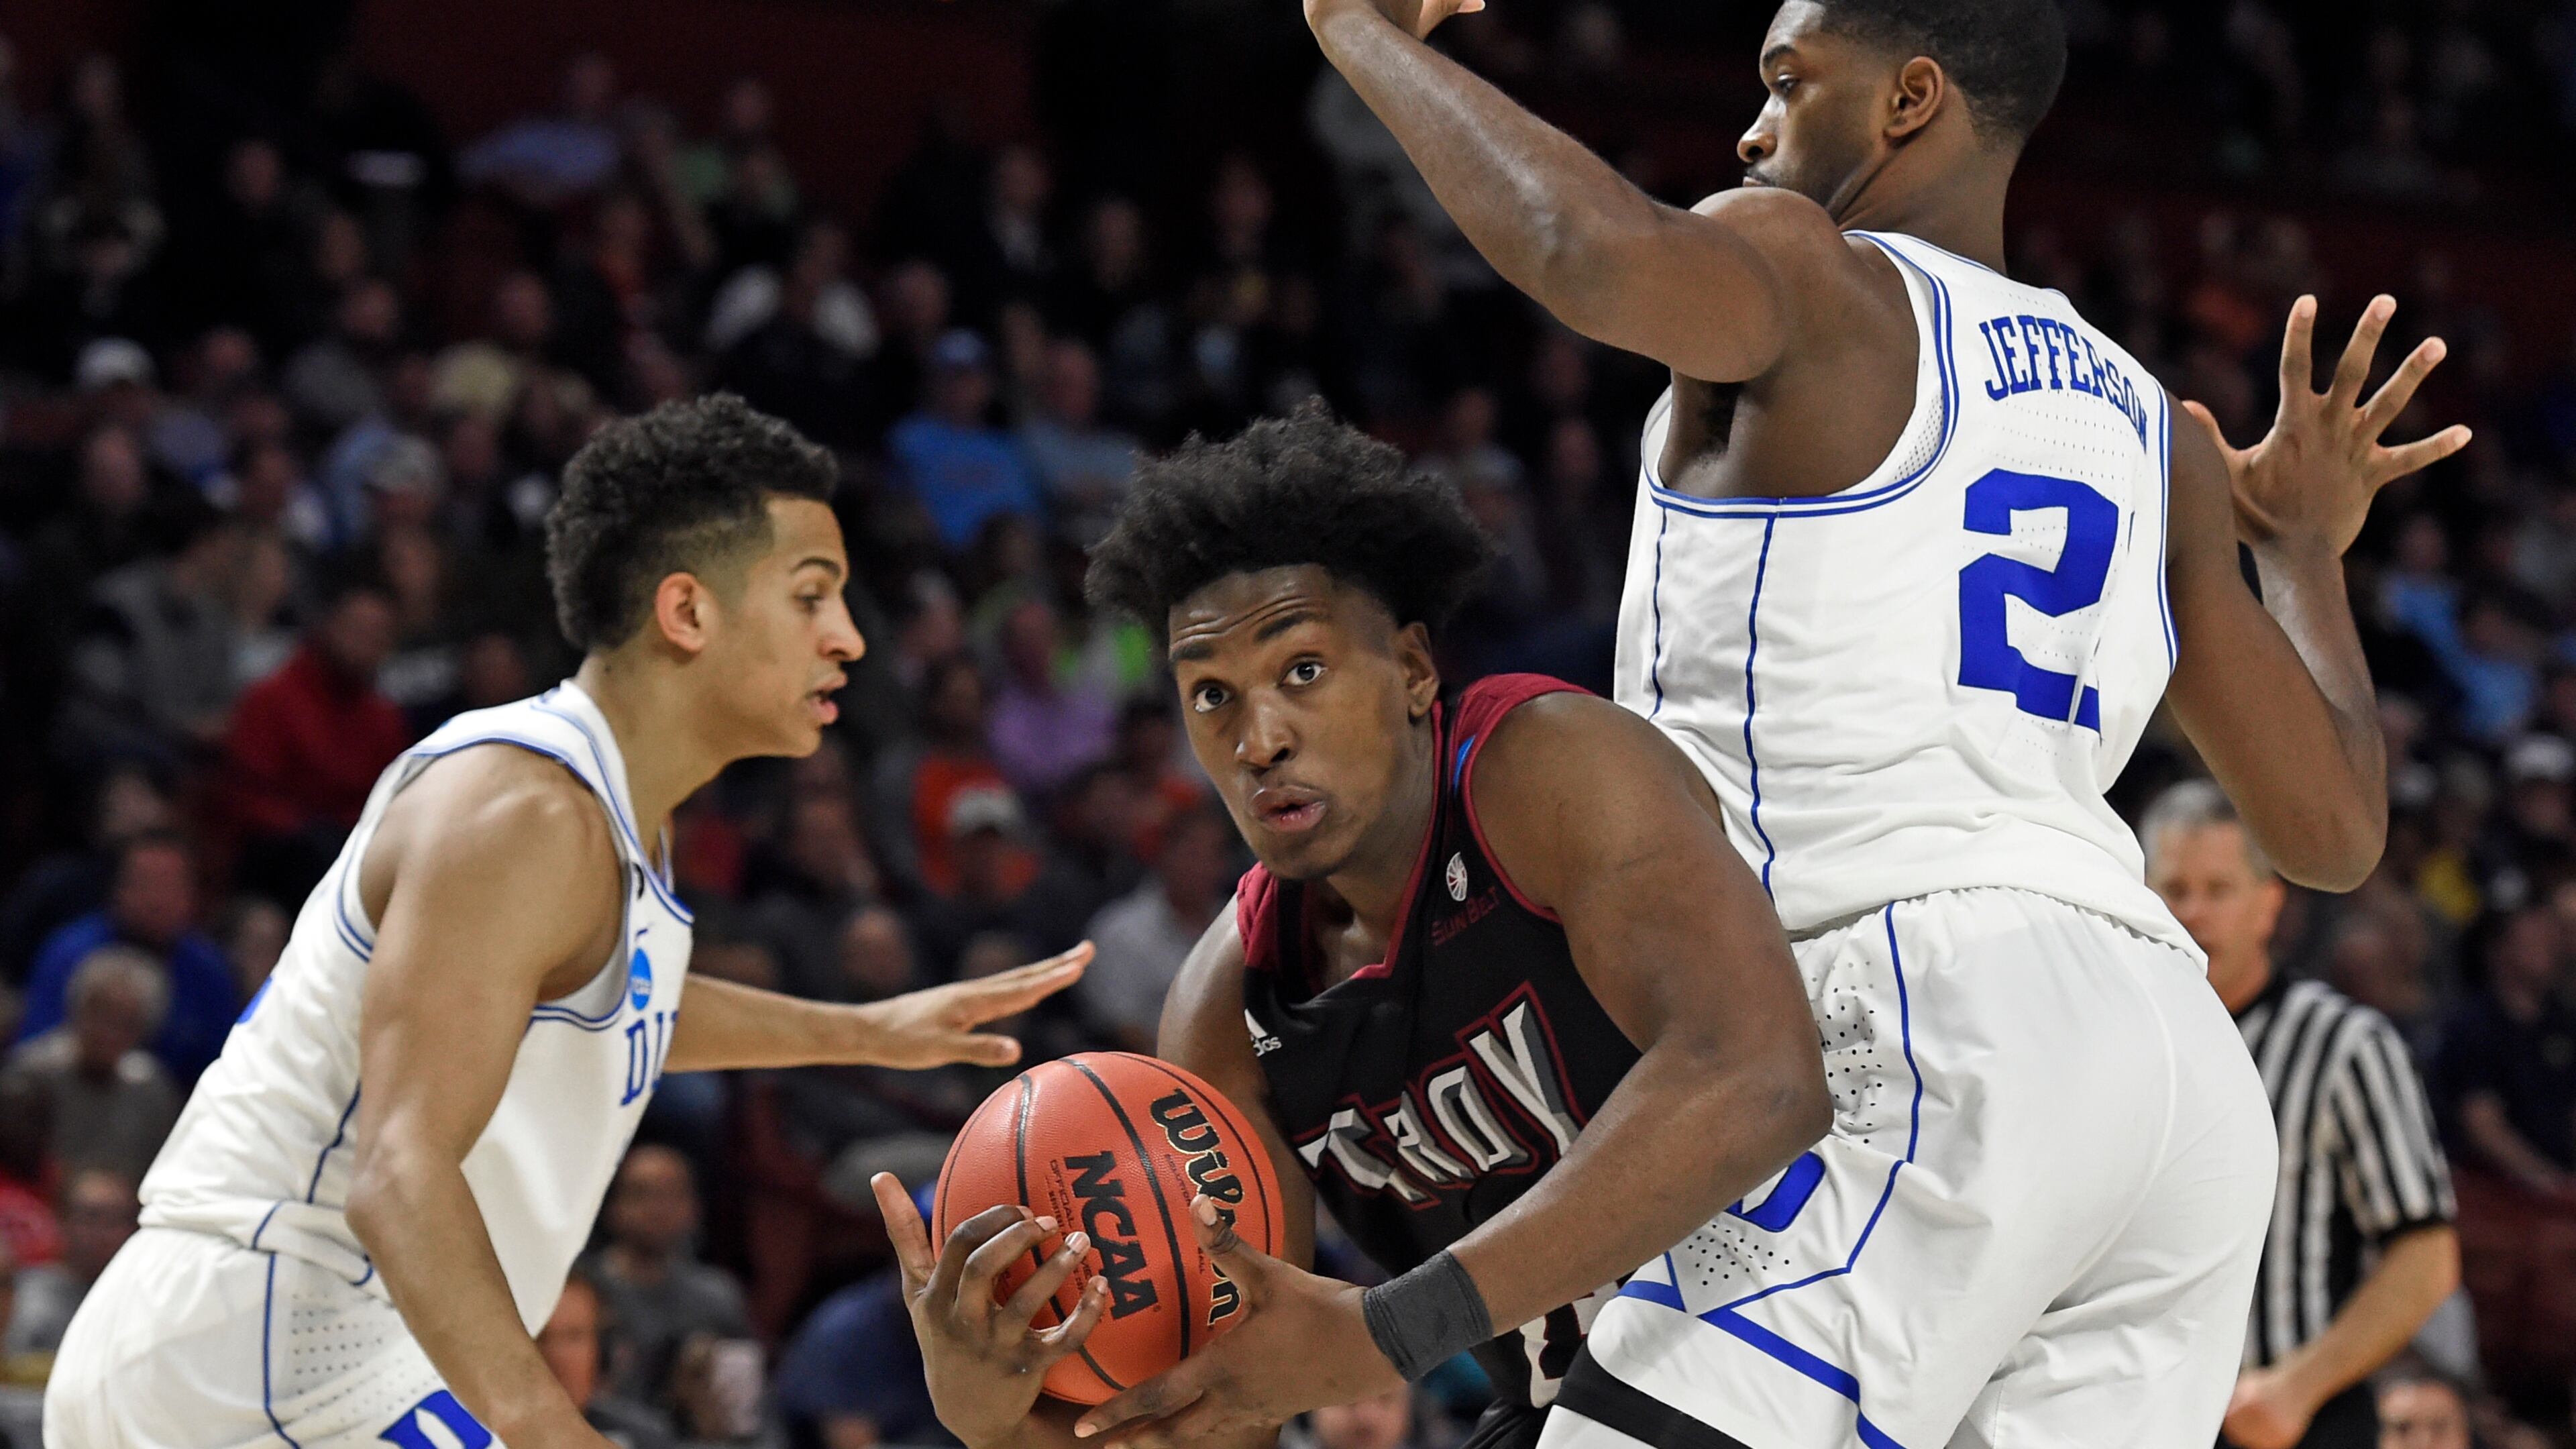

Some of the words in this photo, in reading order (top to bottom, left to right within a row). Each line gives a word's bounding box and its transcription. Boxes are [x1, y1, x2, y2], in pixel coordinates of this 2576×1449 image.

[1979, 315, 2147, 453] JEFFERSON
[1297, 1000, 1582, 1203] TROY
[1064, 1150, 1159, 1320] NCAA
